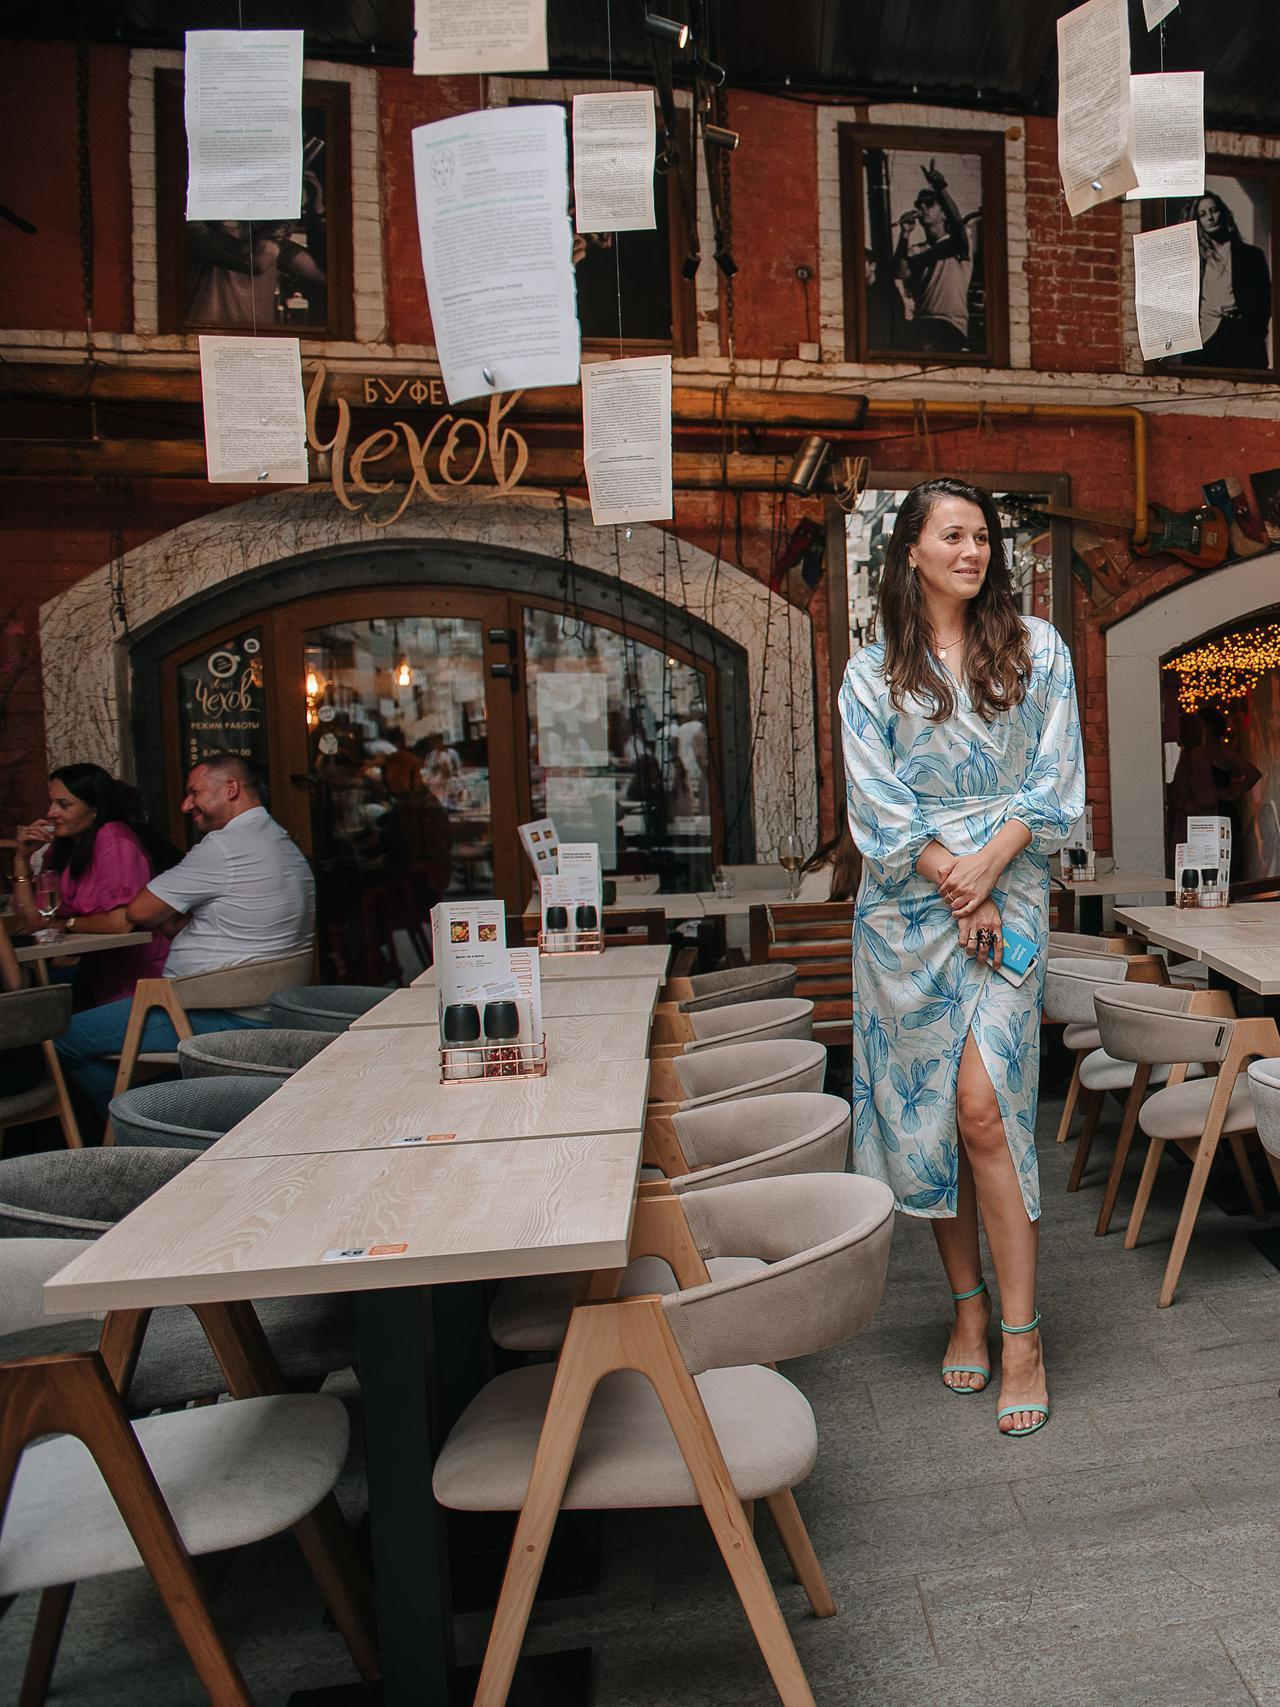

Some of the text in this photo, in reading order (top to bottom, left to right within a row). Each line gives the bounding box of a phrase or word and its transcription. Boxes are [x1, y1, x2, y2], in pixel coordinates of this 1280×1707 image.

[363, 378, 444, 405] БУФЕ
[302, 361, 580, 528] Чехов
[195, 667, 260, 720] Чехов
[191, 721, 259, 731] РЕЖИМ РАБОТЫ
